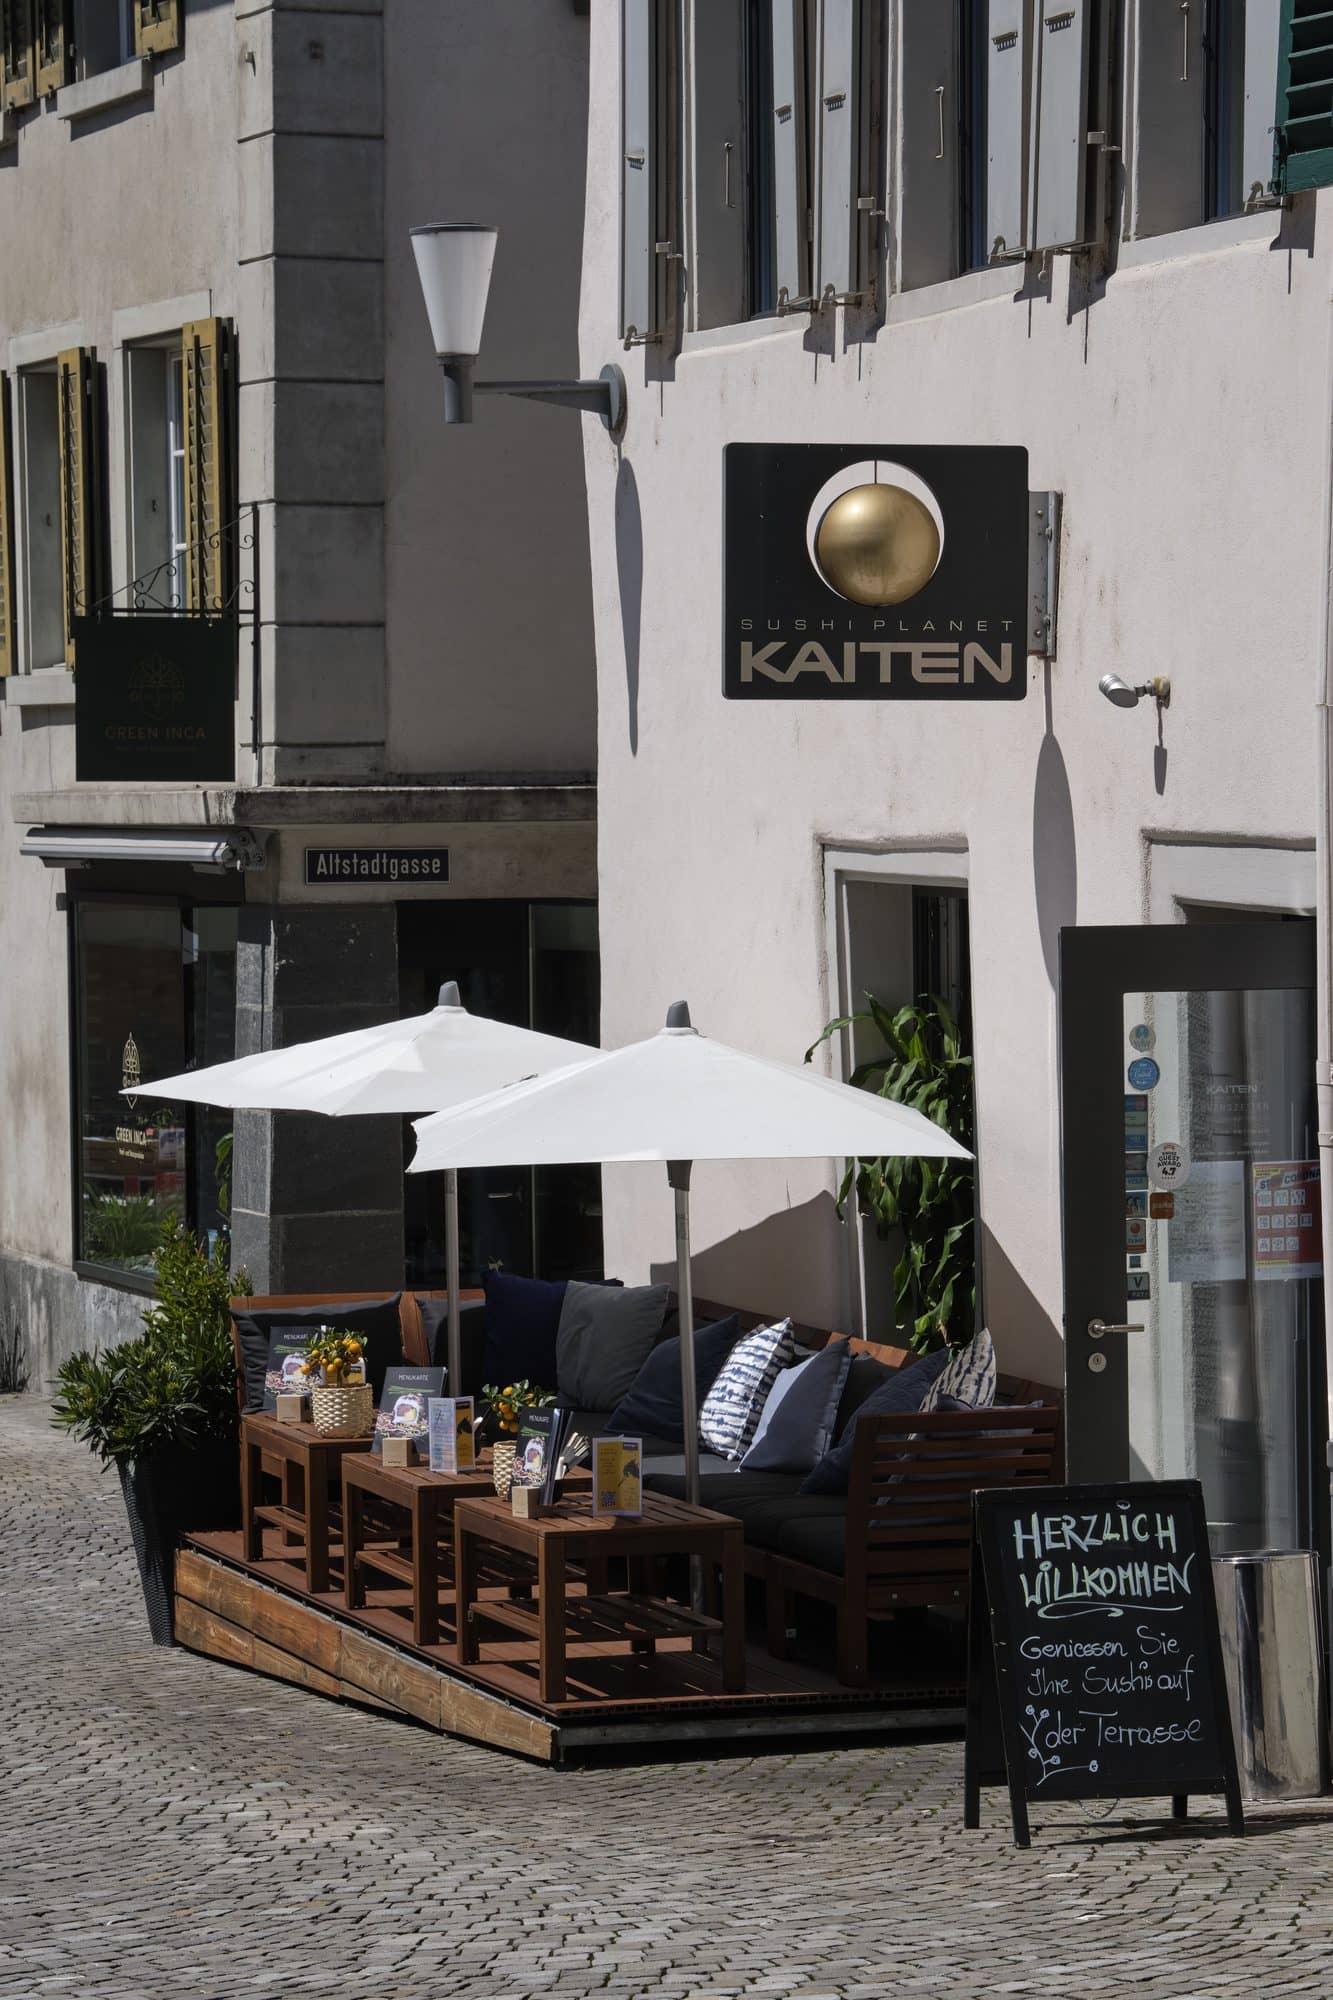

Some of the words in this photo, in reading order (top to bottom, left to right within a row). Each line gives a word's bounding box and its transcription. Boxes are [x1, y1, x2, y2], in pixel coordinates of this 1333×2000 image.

[740, 640, 1013, 684] KAITEN
[104, 726, 158, 740] GREEN
[165, 726, 207, 740] INCA
[316, 853, 441, 880] Altstadtgasse
[115, 1126, 132, 1143] GREEN
[1157, 1160, 1182, 1168] AWARD
[1158, 1154, 1180, 1162] GUEST
[1162, 1167, 1177, 1176] 4.7
[1020, 1635, 1129, 1660] Geniessen
[1136, 1625, 1181, 1656] Sie
[1027, 1667, 1073, 1696] Ihre
[1157, 1654, 1195, 1702] auf
[1045, 1710, 1086, 1749] der
[1078, 1710, 1205, 1747] Terrasse
